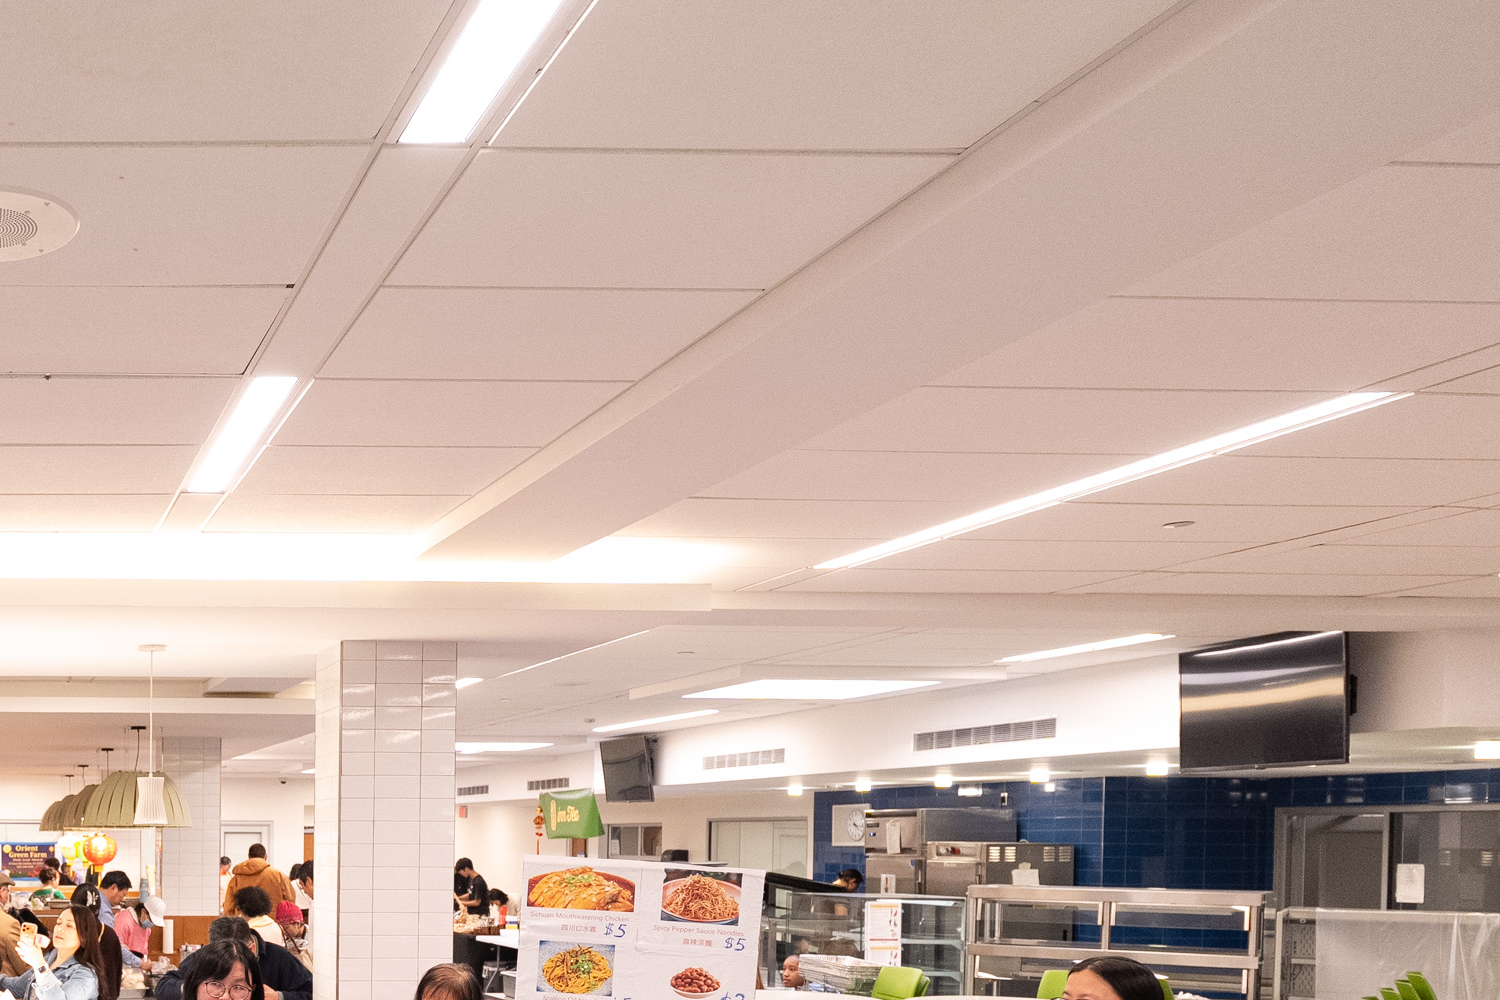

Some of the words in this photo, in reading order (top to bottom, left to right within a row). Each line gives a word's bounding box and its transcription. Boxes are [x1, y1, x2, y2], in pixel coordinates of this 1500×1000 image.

[15, 844, 39, 852] Orient
[8, 851, 29, 859] Green
[29, 851, 48, 859] Farm
[530, 911, 555, 919] Sichuan
[555, 912, 604, 922] Mouthwatering
[603, 922, 628, 938] $5
[653, 924, 671, 932] Spicy
[671, 926, 695, 934] Pepper
[696, 927, 716, 935] Sauce
[716, 929, 745, 937] Noodles
[723, 937, 747, 952] $5
